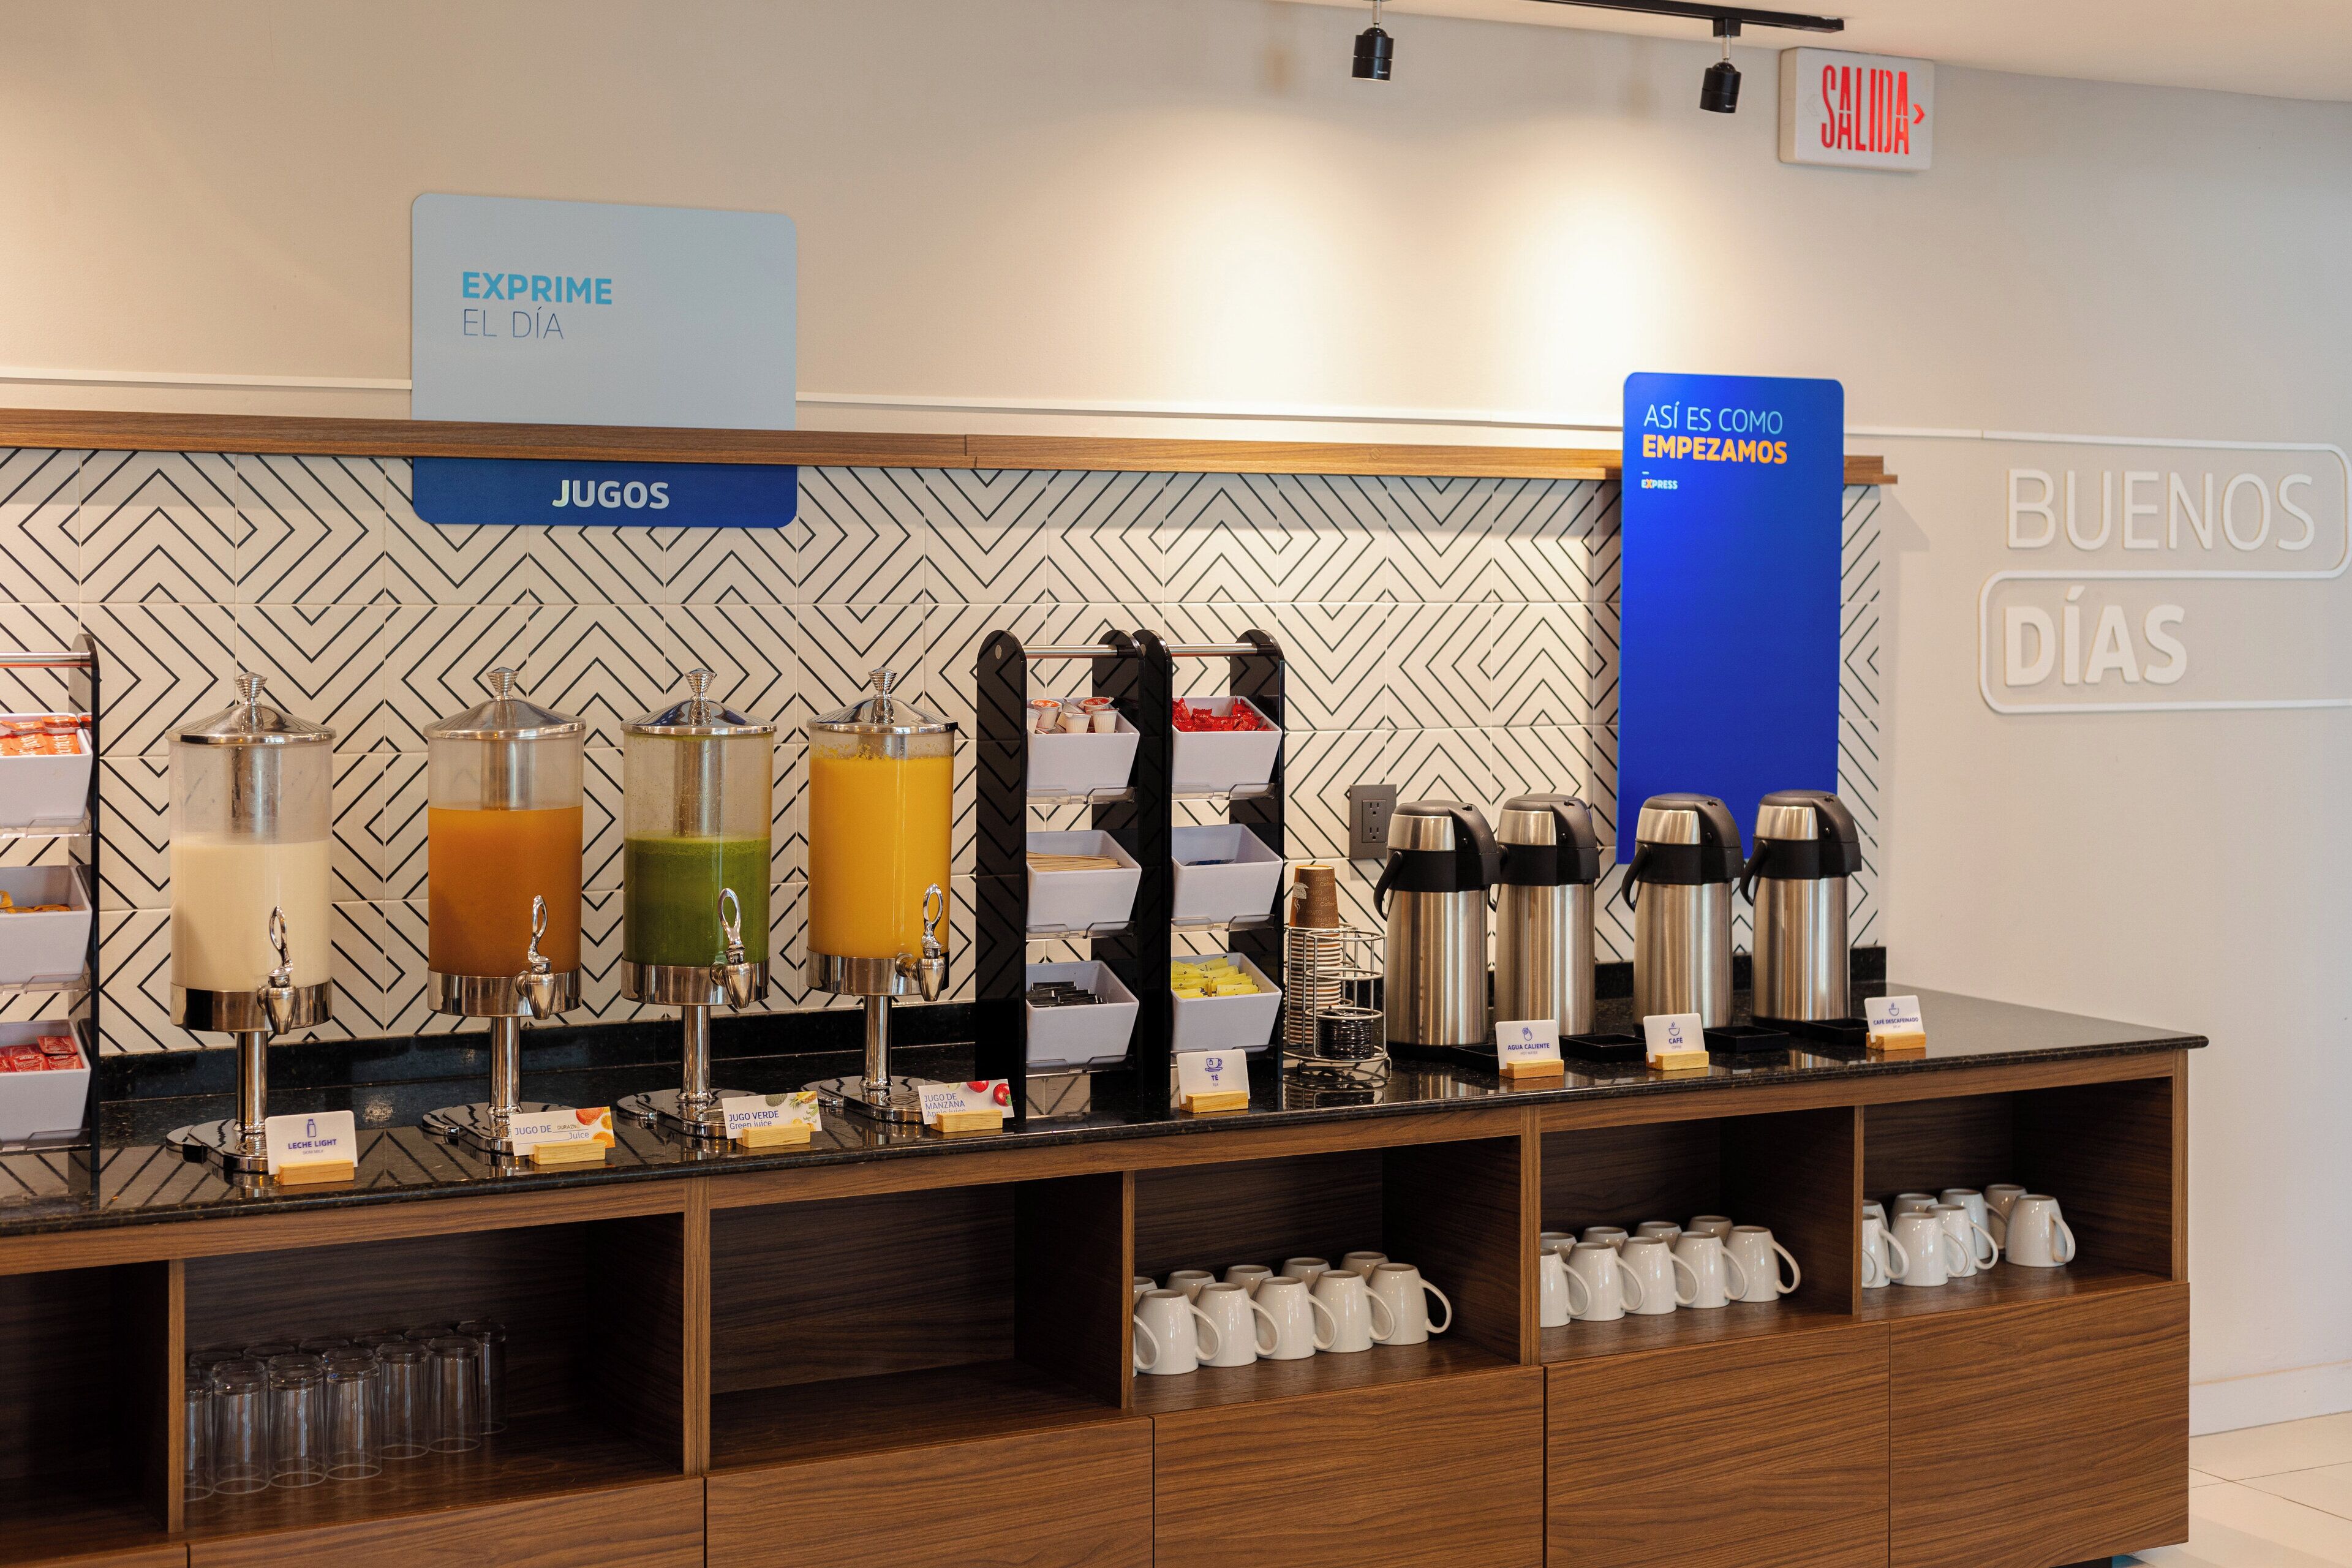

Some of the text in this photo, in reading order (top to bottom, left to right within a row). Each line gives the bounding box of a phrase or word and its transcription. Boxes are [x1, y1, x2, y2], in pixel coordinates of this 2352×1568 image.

[1821, 64, 1909, 154] SALIDA
[462, 271, 612, 305] EXPRIME
[463, 307, 564, 339] EL DÍA
[1643, 401, 1783, 435] ASÍ ES COMO
[1642, 434, 1788, 464] EMPEZAMOS
[552, 480, 669, 509] JUGOS
[1641, 479, 1678, 489] EXPRESS
[2007, 469, 2315, 551] BUENOS
[2005, 586, 2188, 686] DÍAS
[924, 1094, 944, 1102] JUGO
[925, 1100, 965, 1110] MANZANA
[729, 1110, 779, 1121] JUGO VERDE
[514, 1126, 538, 1136] JUGO
